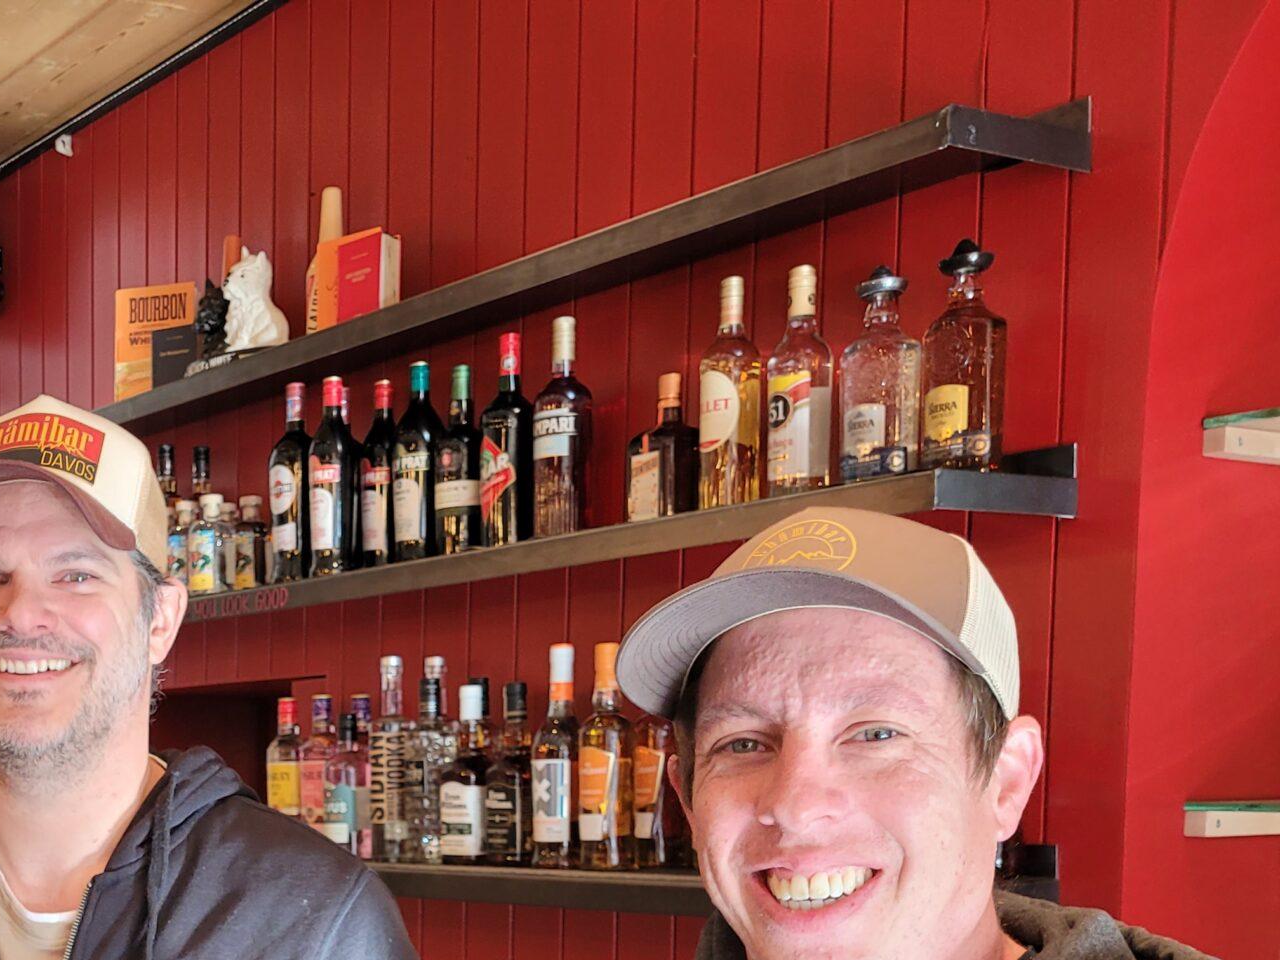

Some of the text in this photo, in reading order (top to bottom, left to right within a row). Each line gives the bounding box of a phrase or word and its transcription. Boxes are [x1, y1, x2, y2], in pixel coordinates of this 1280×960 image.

[129, 292, 187, 324] BOURBON
[768, 400, 786, 423] 51
[40, 449, 96, 483] DAVOS
[255, 587, 289, 612] GOOD
